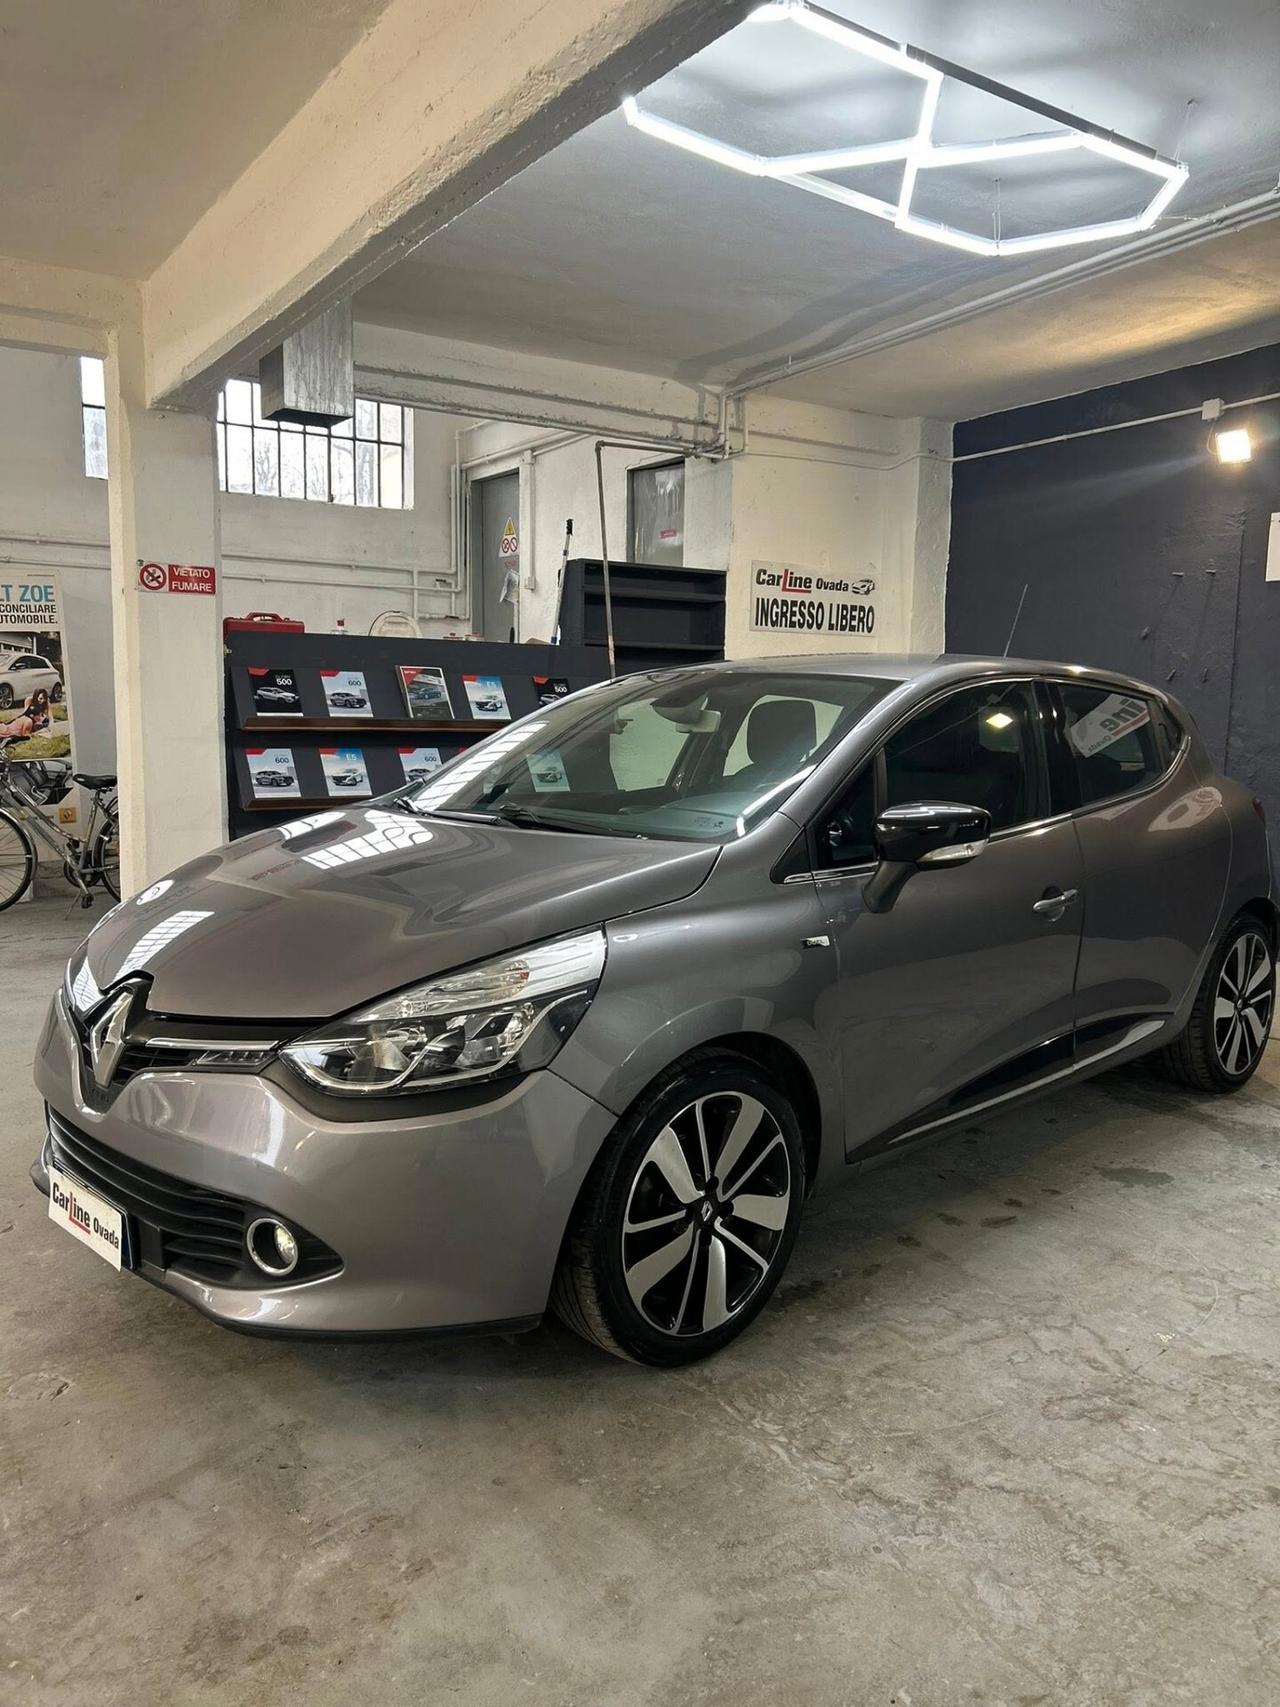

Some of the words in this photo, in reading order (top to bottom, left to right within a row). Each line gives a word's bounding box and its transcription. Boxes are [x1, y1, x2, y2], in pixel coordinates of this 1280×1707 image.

[173, 567, 211, 579] VIETATO
[172, 581, 212, 592] FUMARE
[755, 568, 812, 594] CarLine
[816, 577, 849, 592] Ovada
[18, 584, 56, 603] ZOE
[755, 597, 825, 630] INGRESSO
[828, 603, 875, 634] LIBERO
[276, 678, 293, 686] 500
[275, 756, 290, 764] 600
[52, 1182, 91, 1235] CarLine
[93, 1216, 120, 1250] Ovada
